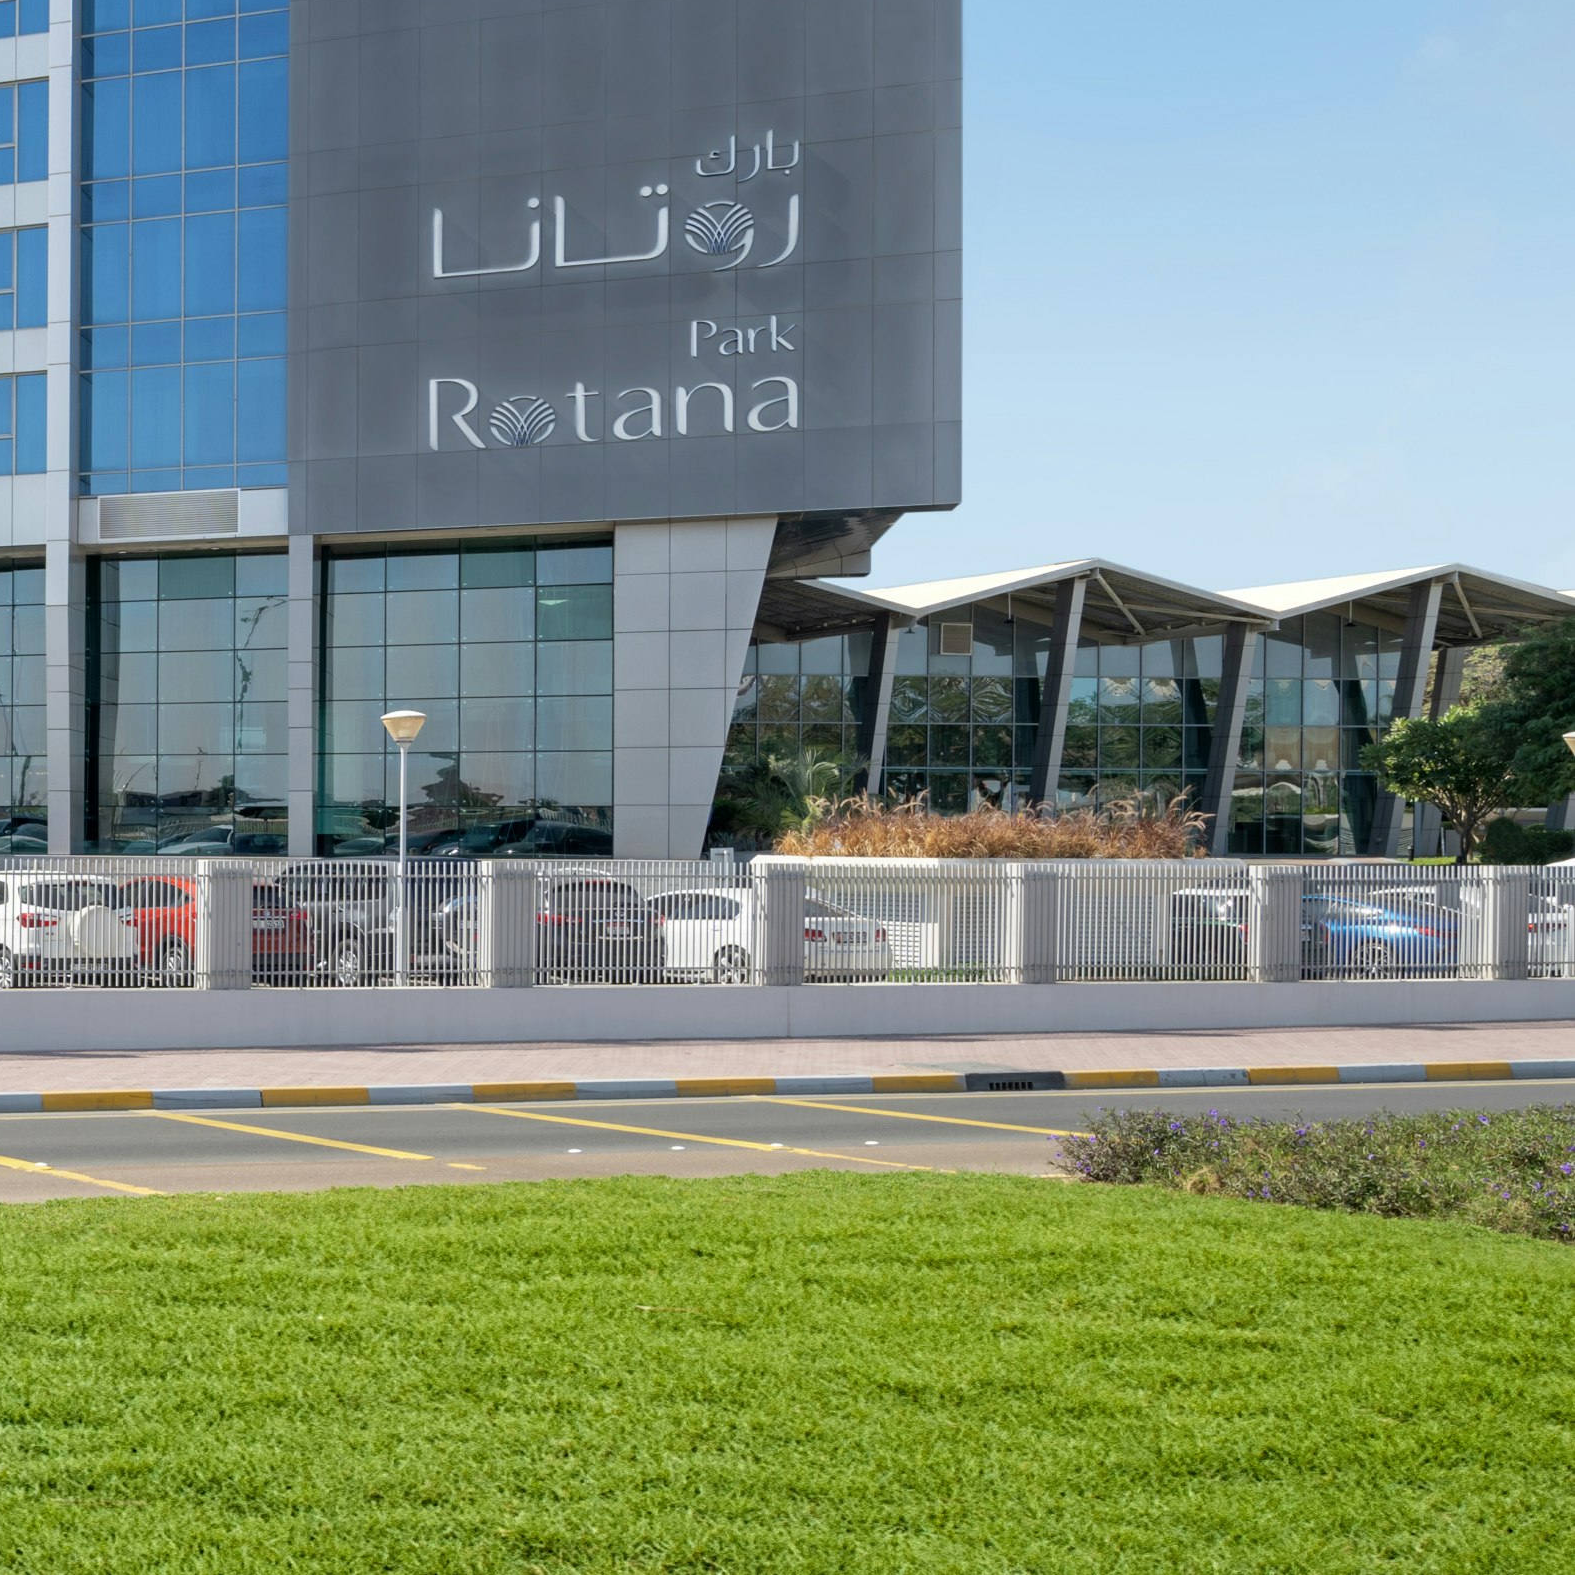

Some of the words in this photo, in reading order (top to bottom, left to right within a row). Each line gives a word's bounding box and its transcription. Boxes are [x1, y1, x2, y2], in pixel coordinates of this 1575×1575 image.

[696, 129, 799, 182] بارك
[433, 183, 799, 278] روتانا
[690, 315, 796, 357] Park
[428, 376, 799, 451] Rotana
